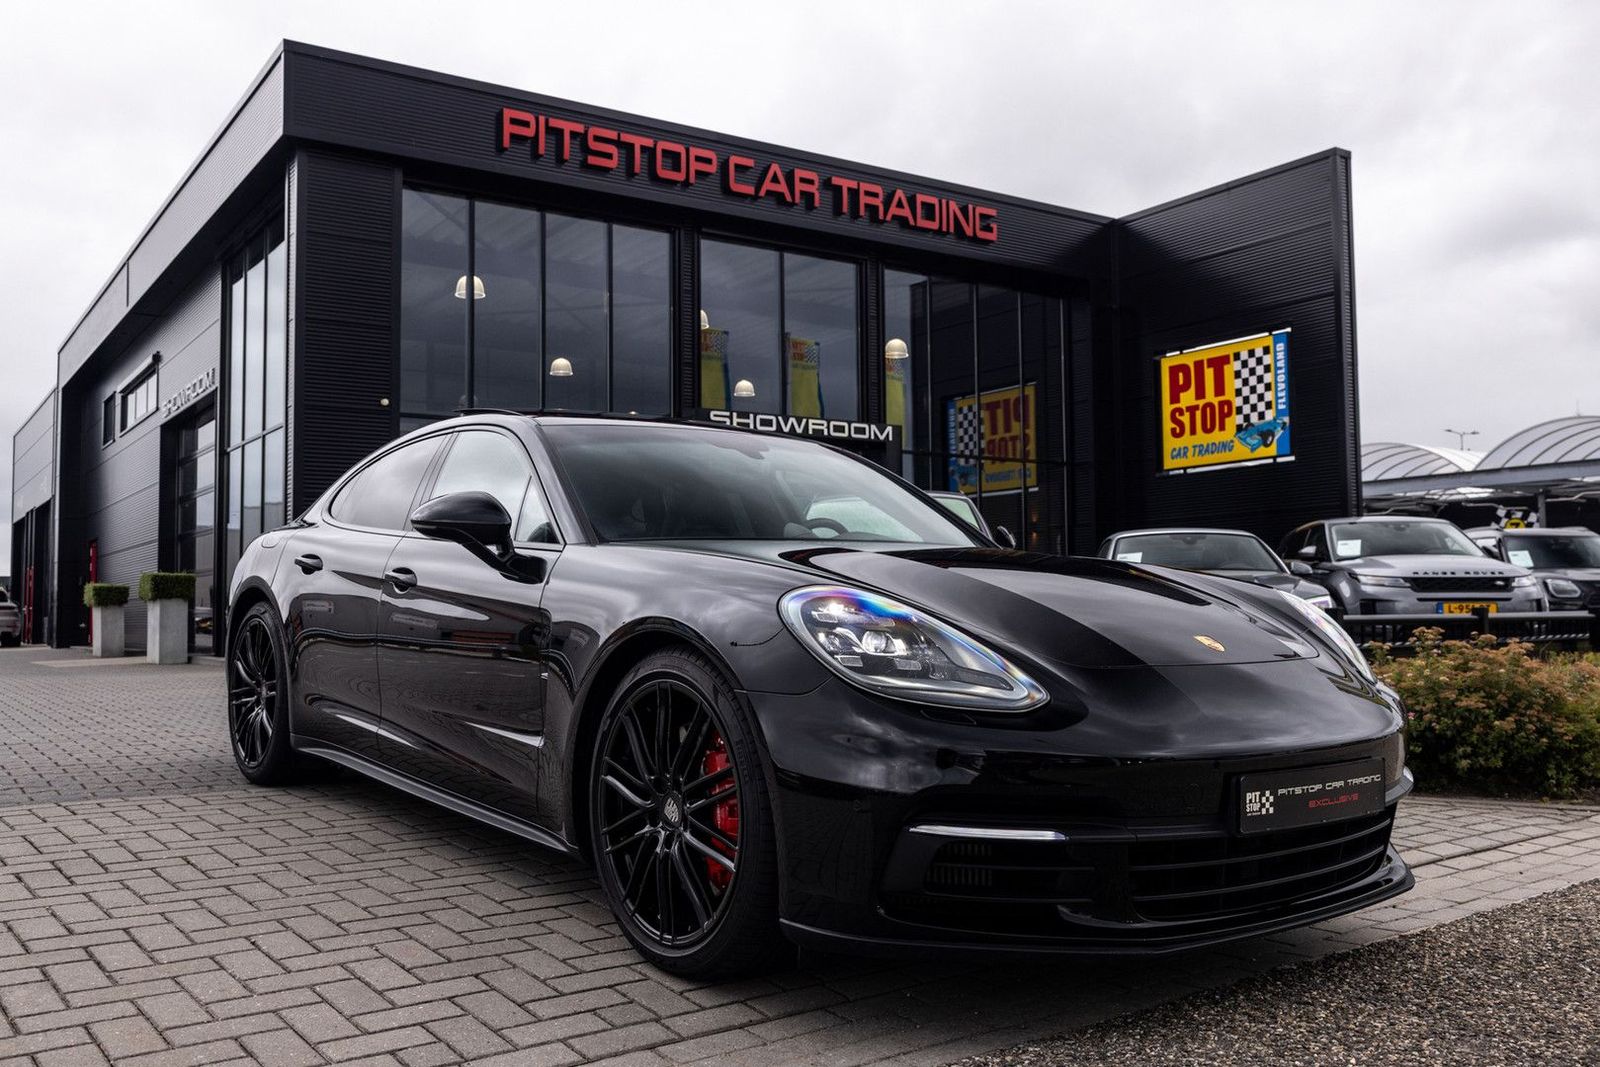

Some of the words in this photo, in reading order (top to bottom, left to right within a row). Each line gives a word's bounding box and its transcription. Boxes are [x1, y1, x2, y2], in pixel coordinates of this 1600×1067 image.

[502, 108, 717, 184] PITSTOP
[727, 156, 820, 208] CAR
[831, 176, 998, 242] TRADING
[1168, 354, 1231, 405] PIT
[1276, 343, 1287, 410] FLEVOLAND
[709, 410, 893, 441] SHOWROOM
[1170, 399, 1234, 439] STOP
[1170, 447, 1189, 460] CAR
[1192, 440, 1235, 457] TRADING
[1246, 791, 1261, 803] PIT
[1278, 784, 1323, 796] PITSTOP
[1325, 781, 1345, 790] CAR
[1308, 793, 1359, 808] EXCLUSIVE
[1246, 803, 1261, 812] STOP
